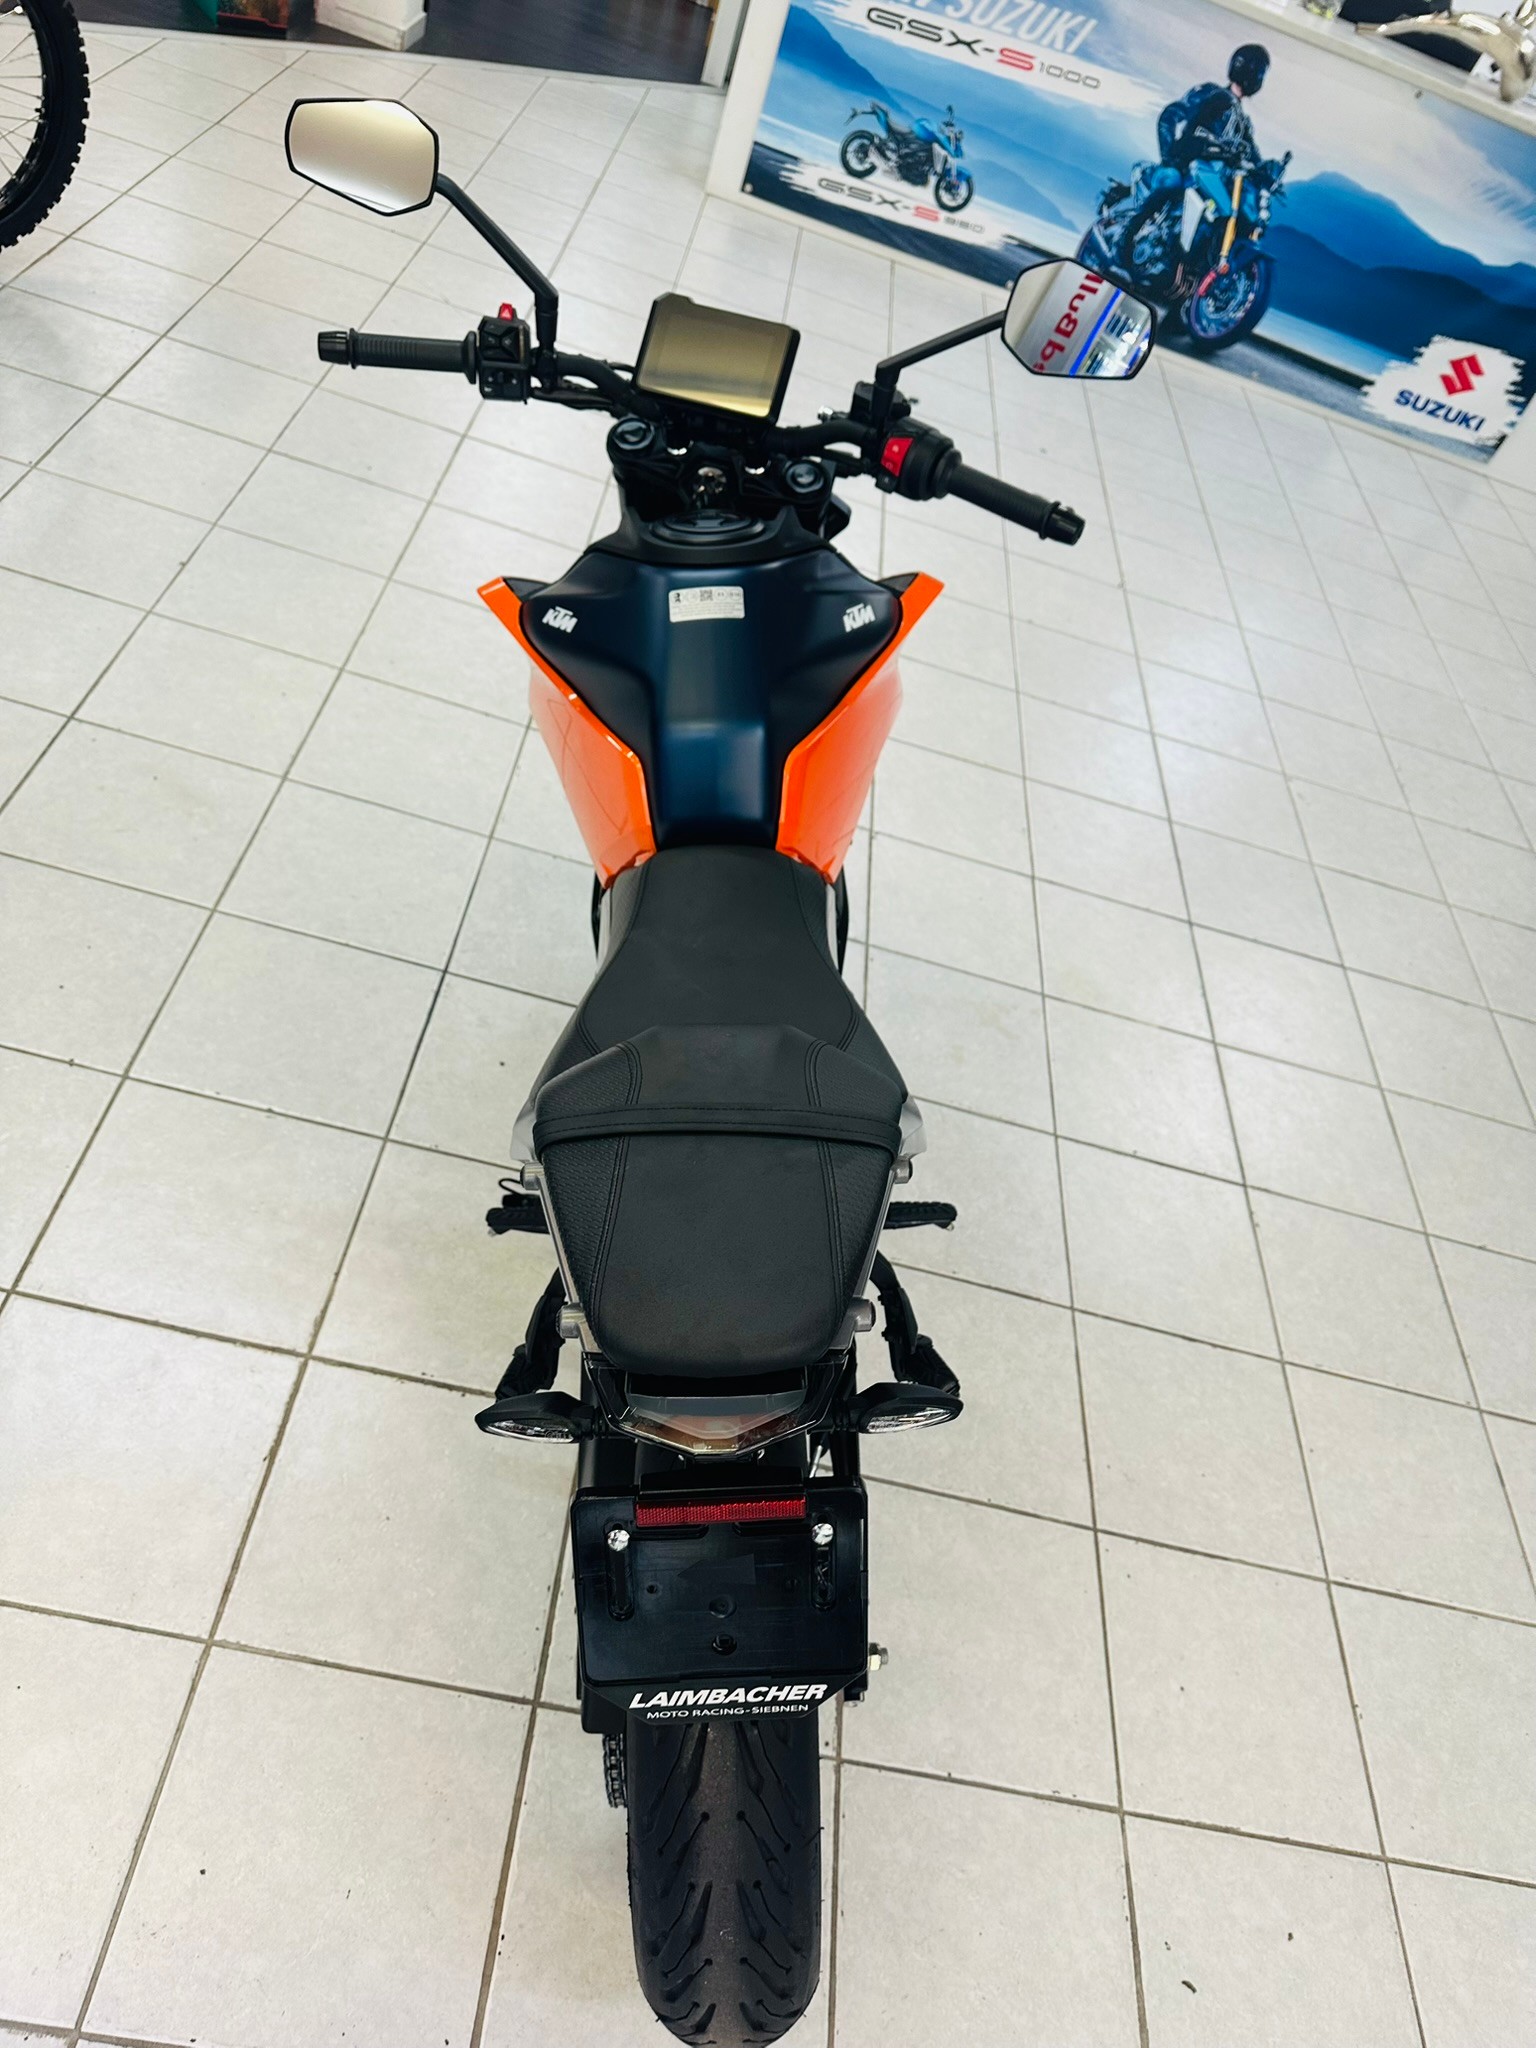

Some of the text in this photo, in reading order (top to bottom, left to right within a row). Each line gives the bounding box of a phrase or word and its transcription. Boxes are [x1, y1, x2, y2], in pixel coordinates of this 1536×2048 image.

[1394, 389, 1486, 432] SUZUKI
[542, 605, 578, 633] KTM
[842, 603, 876, 633] KTM
[629, 1684, 828, 1709] LAIMBACHER
[646, 1711, 690, 1720] MOTO
